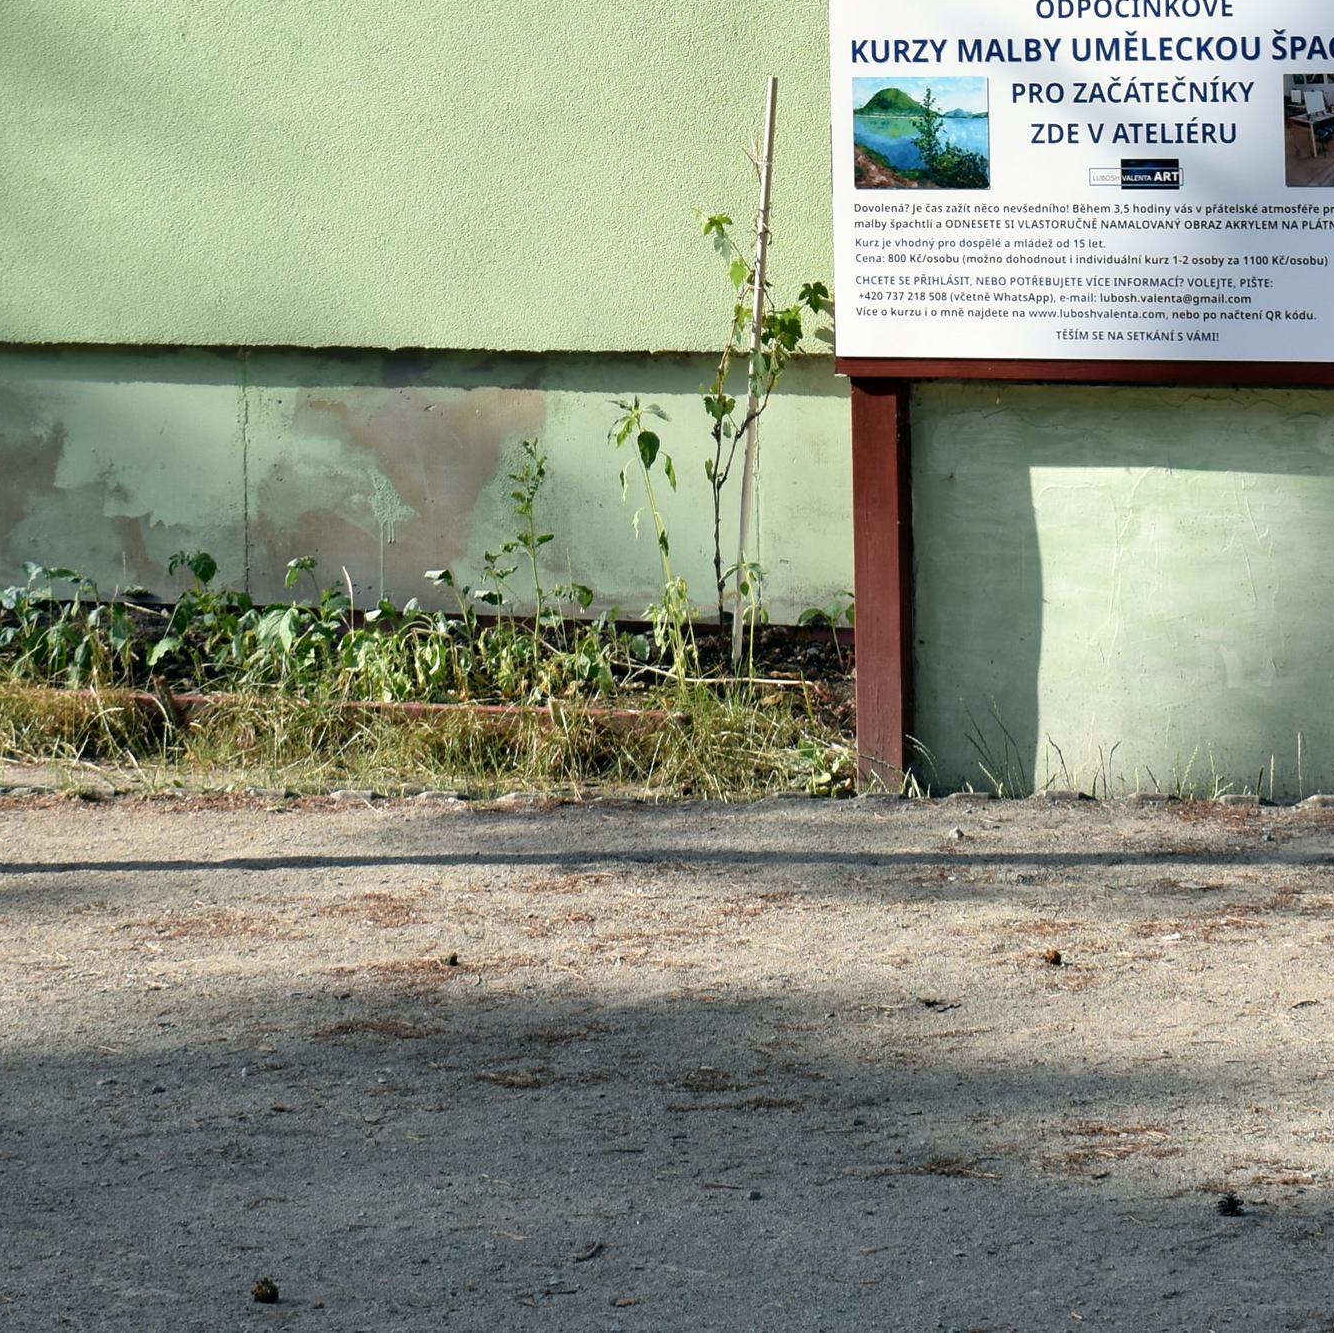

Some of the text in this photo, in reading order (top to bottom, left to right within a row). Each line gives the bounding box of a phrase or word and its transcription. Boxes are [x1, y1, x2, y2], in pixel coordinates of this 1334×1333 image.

[851, 39, 947, 63] KURZY
[958, 38, 1062, 63] MALBY
[1072, 30, 1261, 62] UMĚLECKOU
[1012, 76, 1255, 103] PRO ZAČÁTEČNÍKY
[1031, 117, 1236, 144] ZDE V ATELIÉRU
[1121, 174, 1152, 182] VALENTA
[1154, 171, 1180, 182] ART
[854, 203, 910, 213] Dovolená?
[912, 204, 922, 215] Je
[925, 203, 943, 213] čas
[945, 203, 971, 213] zažít
[974, 203, 1001, 213] něco
[1003, 204, 1069, 214] nevšedního!
[1072, 204, 1111, 214] Během
[1114, 205, 1130, 215] 3,5
[1133, 204, 1171, 216] hodiny
[1174, 204, 1193, 214] vás
[1205, 204, 1258, 216] přátelské
[1261, 204, 1320, 214] atmosféře
[855, 219, 887, 231] malby
[891, 219, 932, 230] špachtlí
[946, 220, 1001, 228] ODNESETE
[1005, 220, 1014, 228] SI
[1018, 218, 1097, 229] VLASTORUČNĚ
[1101, 218, 1181, 229] NAMALOVANÝ
[1184, 220, 1222, 229] OBRAZ
[1225, 220, 1278, 229] AKRYLEM
[1282, 220, 1298, 229] NA
[856, 238, 879, 247] Kurz
[882, 238, 891, 250] je
[895, 238, 935, 250] vhodný
[938, 240, 956, 250] pro
[959, 238, 1001, 250] dospělé
[1014, 238, 1053, 248] mládež
[1056, 239, 1069, 248] od
[1074, 239, 1085, 248] 15
[1089, 239, 1106, 249] let.
[856, 254, 884, 262] Cena:
[888, 254, 906, 262] 800
[910, 254, 959, 263] Kč/osobu
[963, 254, 1002, 264] (možno
[1006, 255, 1066, 264] dohodnout
[1070, 255, 1072, 263] i
[1076, 255, 1142, 264] individuální
[1145, 255, 1169, 264] kurz
[1173, 256, 1189, 265] 1-2
[1192, 255, 1225, 267] osoby
[1244, 256, 1268, 265] 1100
[1272, 255, 1328, 267] Kč/osobu)
[856, 274, 1273, 289] CHCETE SE PŘIHLÁSIT, NEBO POTŘEBUJETE VÍCE INFORMACÍ? VOLEJTE, PIŠTE:
[859, 291, 1251, 306] +420 737 218 508 (včetně WhatsApp), e-mail: lubosh.valenta@gmail.com
[856, 307, 878, 316] Více
[891, 307, 921, 316] kurzu
[925, 307, 927, 316] i
[941, 308, 964, 316] mně
[968, 308, 1008, 319] najdete
[1029, 309, 1168, 320] www.luboshvalenta.com,
[1172, 309, 1200, 319] nebo
[1203, 312, 1217, 322] po
[1220, 310, 1262, 319] načtení
[1266, 311, 1281, 321] QR
[1285, 310, 1316, 320] kódu.
[1056, 328, 1219, 341] TĚŠÍM SE NA SETKÁNÍ S VÁMI!
